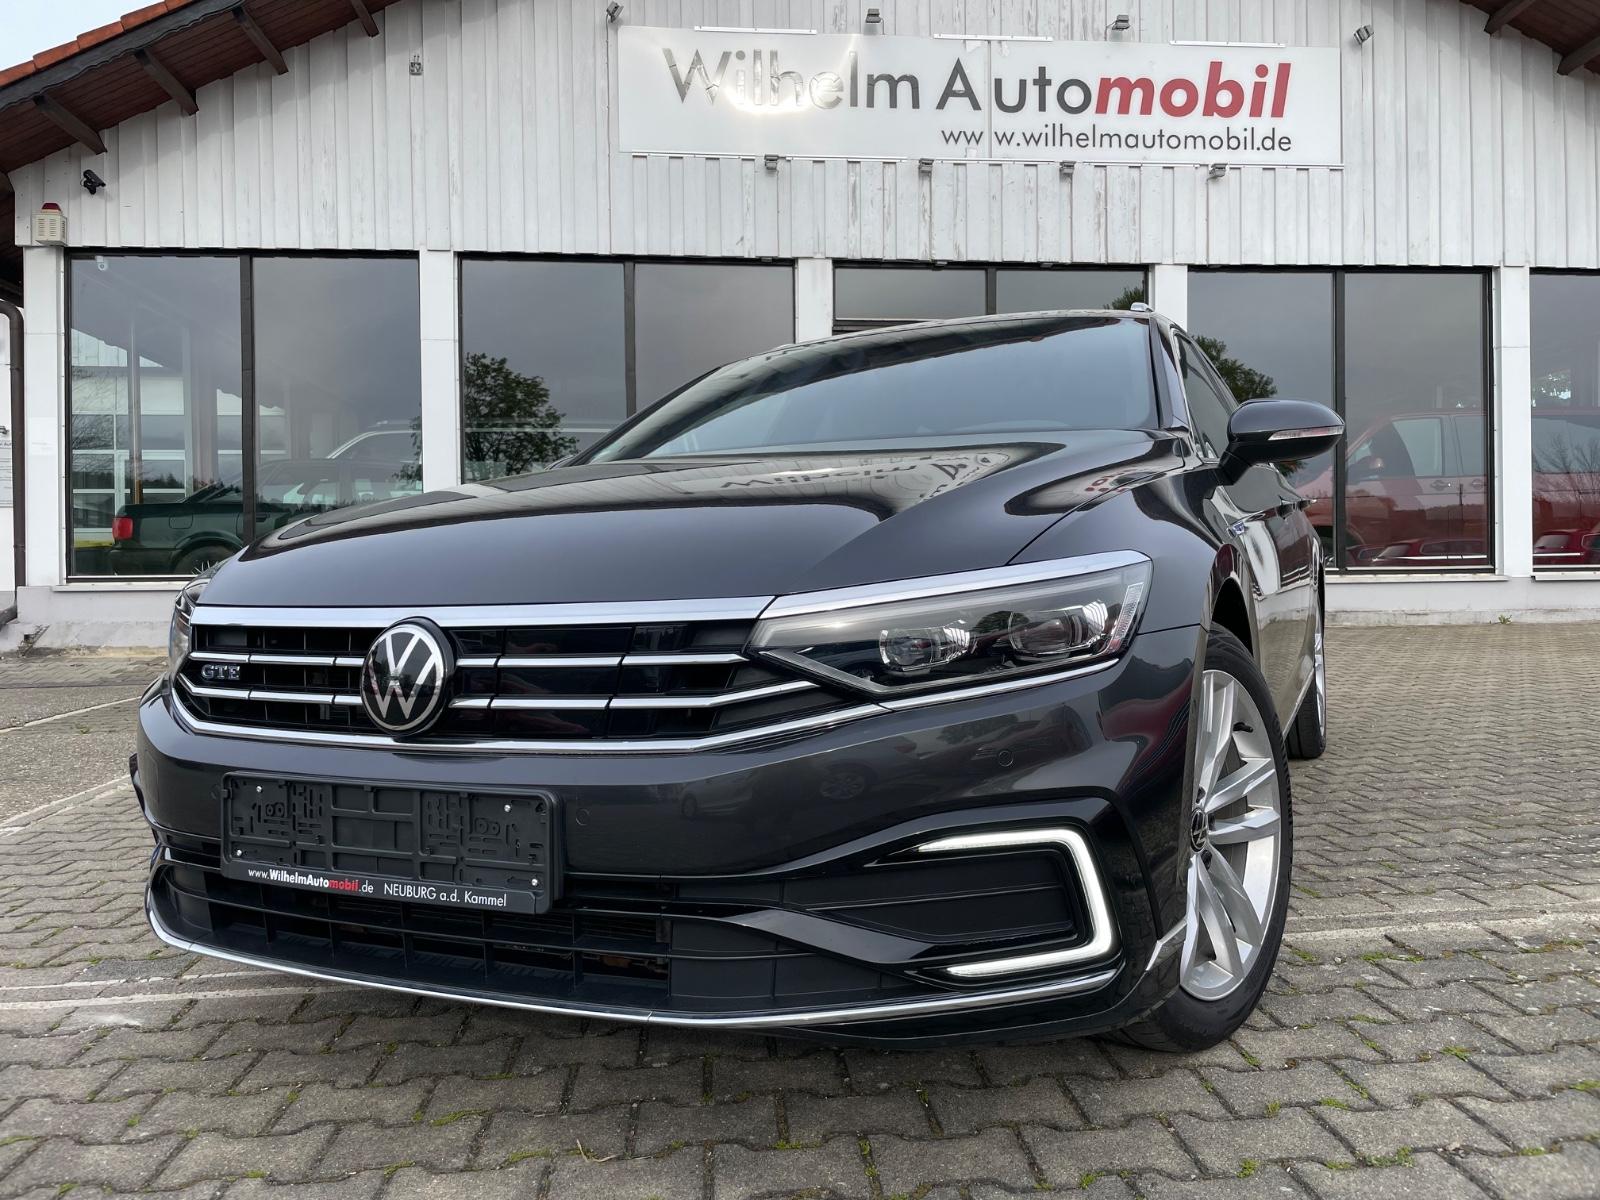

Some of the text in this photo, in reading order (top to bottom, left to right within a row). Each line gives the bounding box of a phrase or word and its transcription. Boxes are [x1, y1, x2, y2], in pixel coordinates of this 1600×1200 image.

[662, 48, 1291, 118] Wilhelm Automobil
[201, 664, 240, 680] GTE
[247, 868, 507, 907] www.WilhelmAutomobil.de NEUBURG a.d. Kammel
